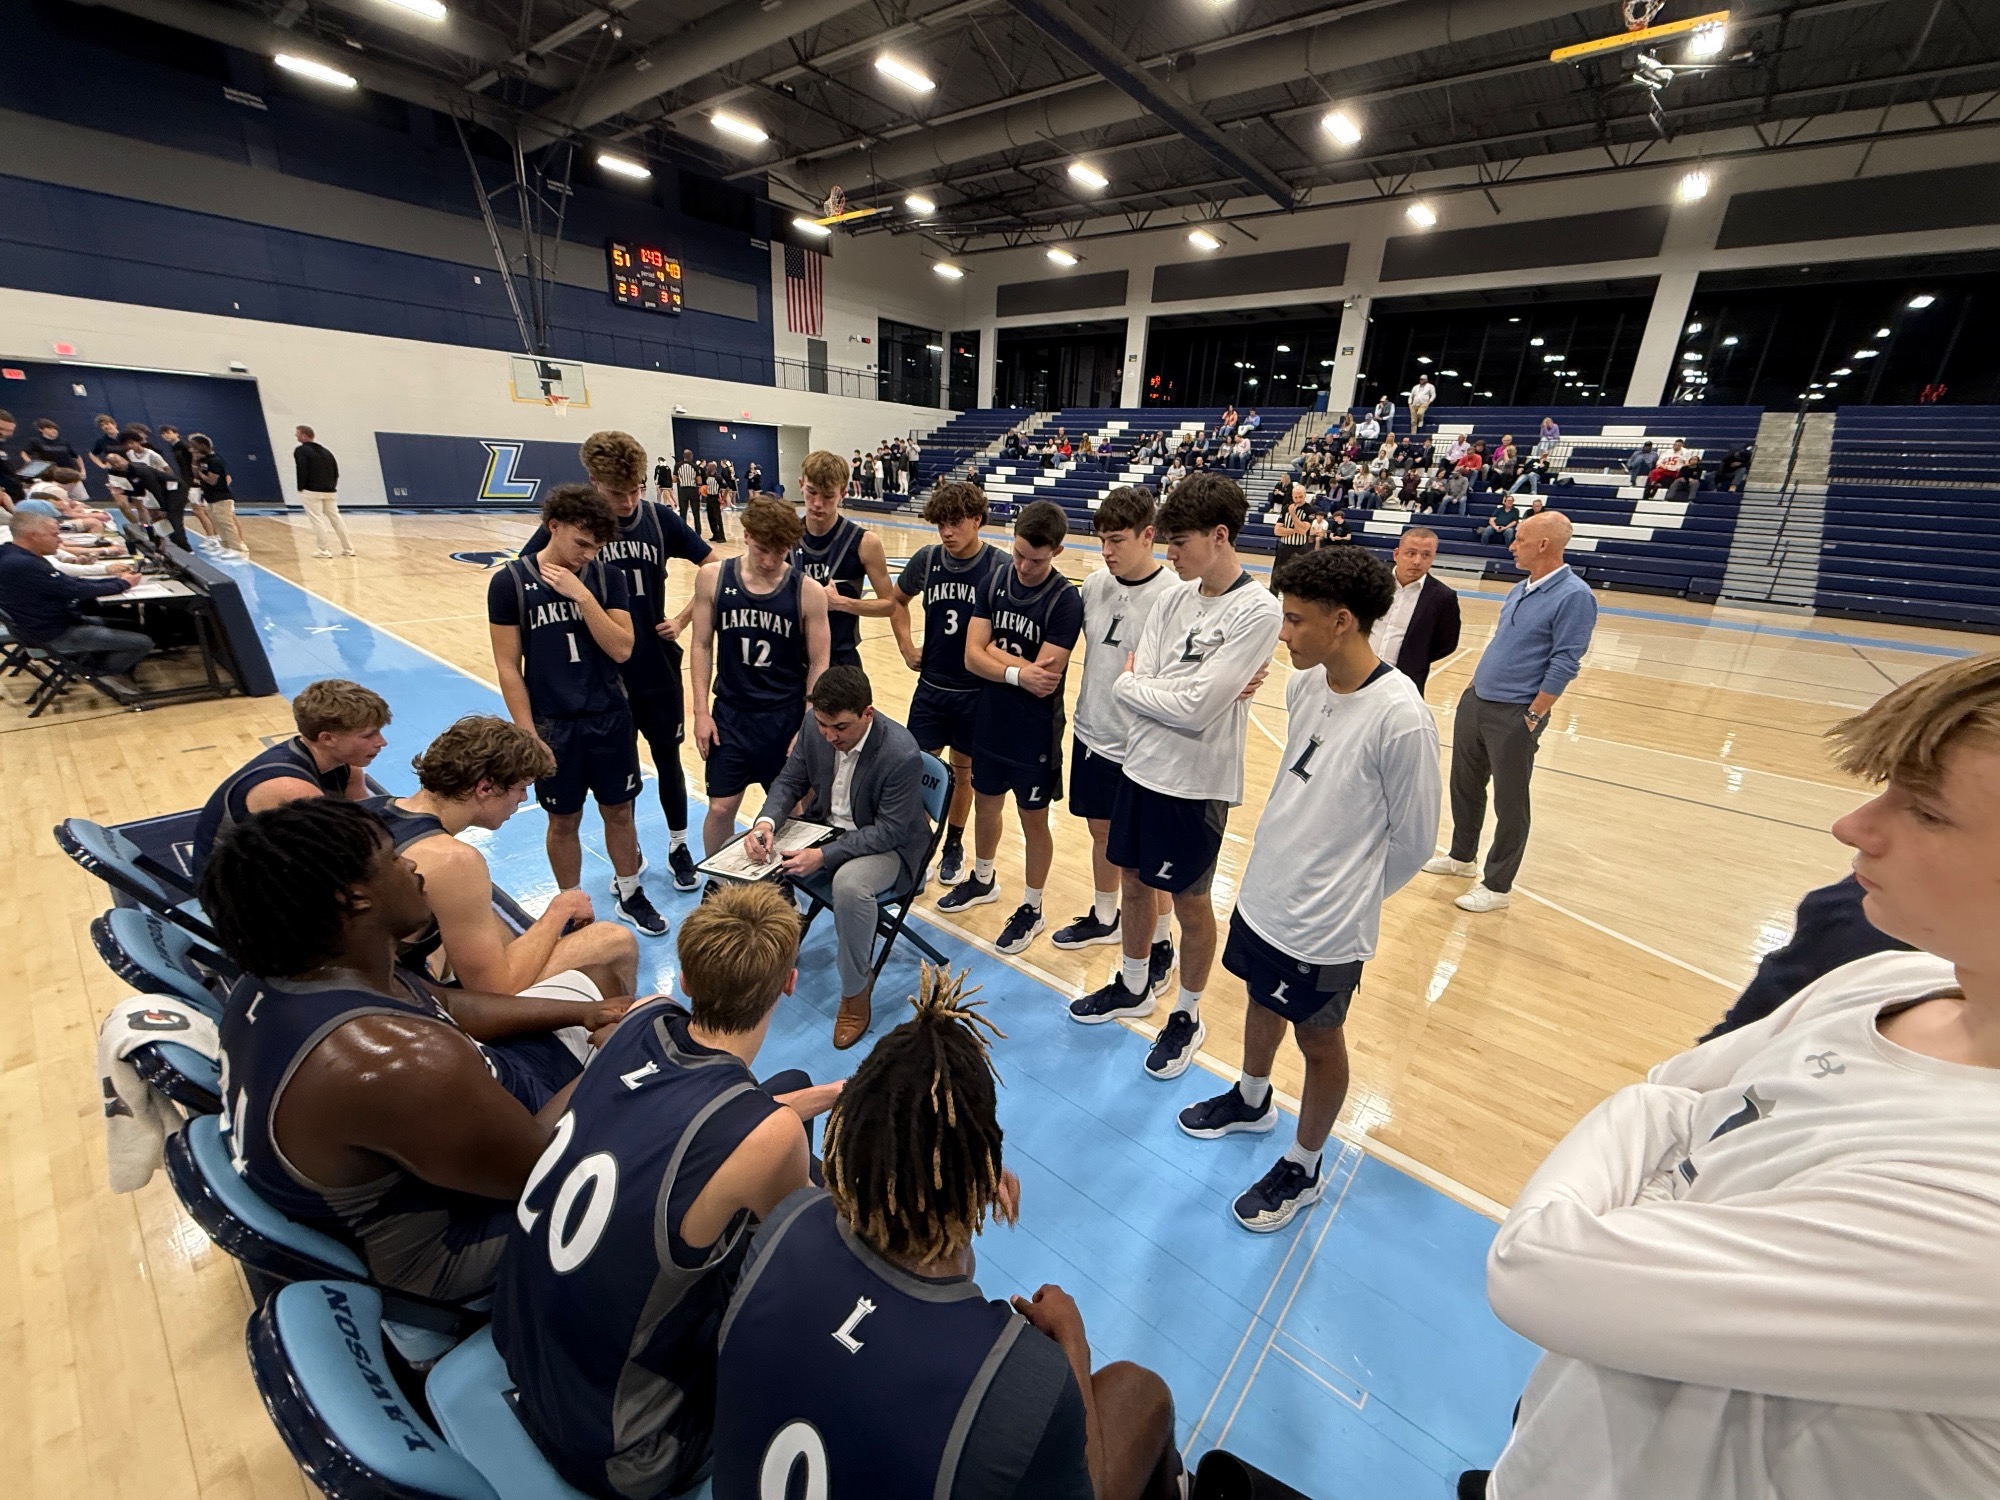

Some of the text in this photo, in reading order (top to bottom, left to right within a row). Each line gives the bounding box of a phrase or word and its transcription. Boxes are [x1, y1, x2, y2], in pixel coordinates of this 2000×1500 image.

[613, 249, 631, 267] 51
[619, 282, 627, 294] 2
[630, 284, 638, 297] 3
[656, 271, 665, 282] 4
[661, 290, 669, 303] 3
[672, 294, 681, 305] 4
[477, 441, 541, 501] L
[928, 582, 976, 605] LAKEWA
[722, 608, 793, 638] LAKEWAY
[944, 609, 959, 635] 3
[1101, 613, 1124, 648] L
[566, 632, 581, 662] 1
[741, 637, 772, 667] 12
[1179, 628, 1205, 662] L
[1288, 733, 1325, 784] L
[620, 1060, 660, 1091] L
[517, 1108, 619, 1276] 20
[831, 1296, 877, 1354] L
[320, 1284, 436, 1452] LAWSON
